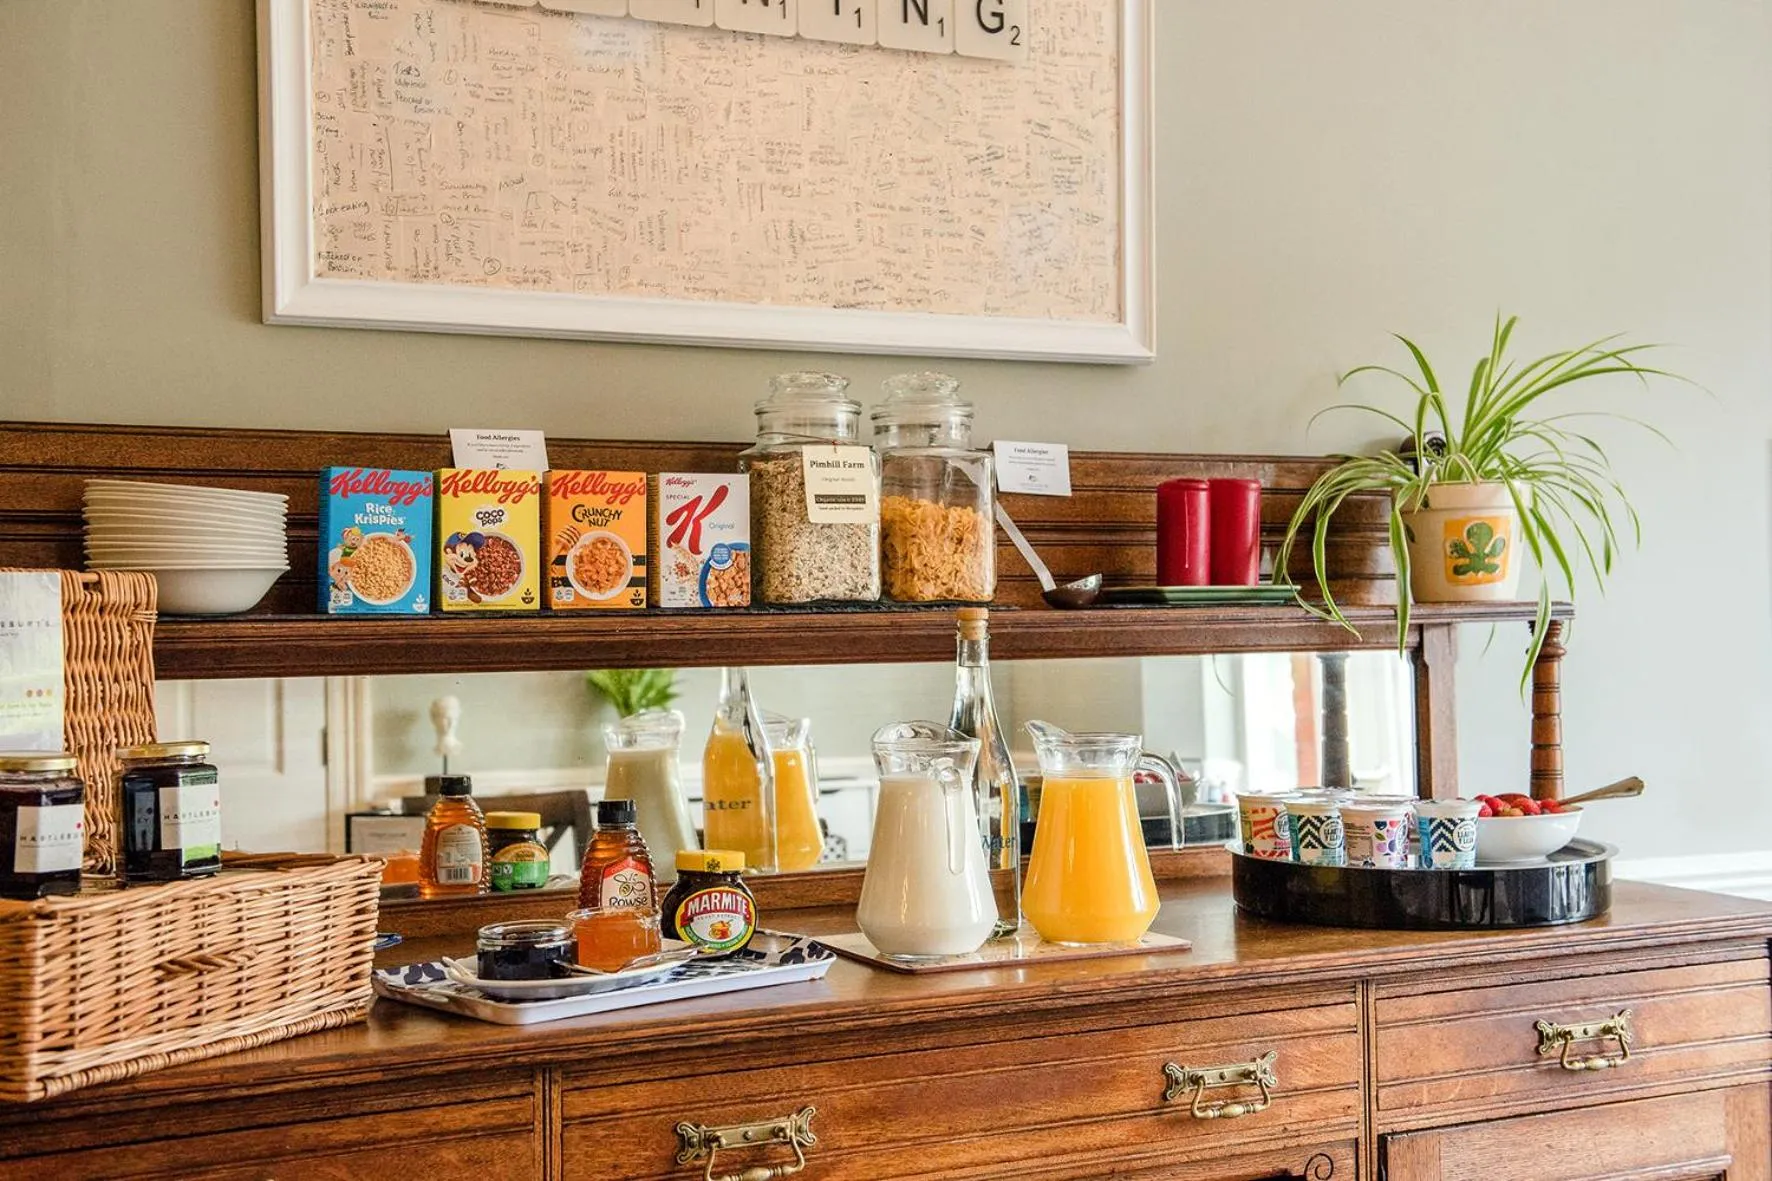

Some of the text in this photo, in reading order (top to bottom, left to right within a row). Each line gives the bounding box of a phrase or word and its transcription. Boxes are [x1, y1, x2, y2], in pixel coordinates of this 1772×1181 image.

[493, 434, 521, 442] Allergies
[810, 460, 865, 469] Pimhill Farm
[330, 467, 433, 506] Kellogg's
[441, 469, 540, 504] Kellogg's
[551, 471, 645, 505] Kellogg's
[365, 502, 393, 515] Rice
[571, 504, 623, 523] CRUNCHY
[354, 513, 405, 526] Krispies
[588, 518, 611, 528] NUT
[666, 485, 729, 555] K
[609, 896, 648, 908] Rowse
[687, 892, 749, 917] MARMITE
